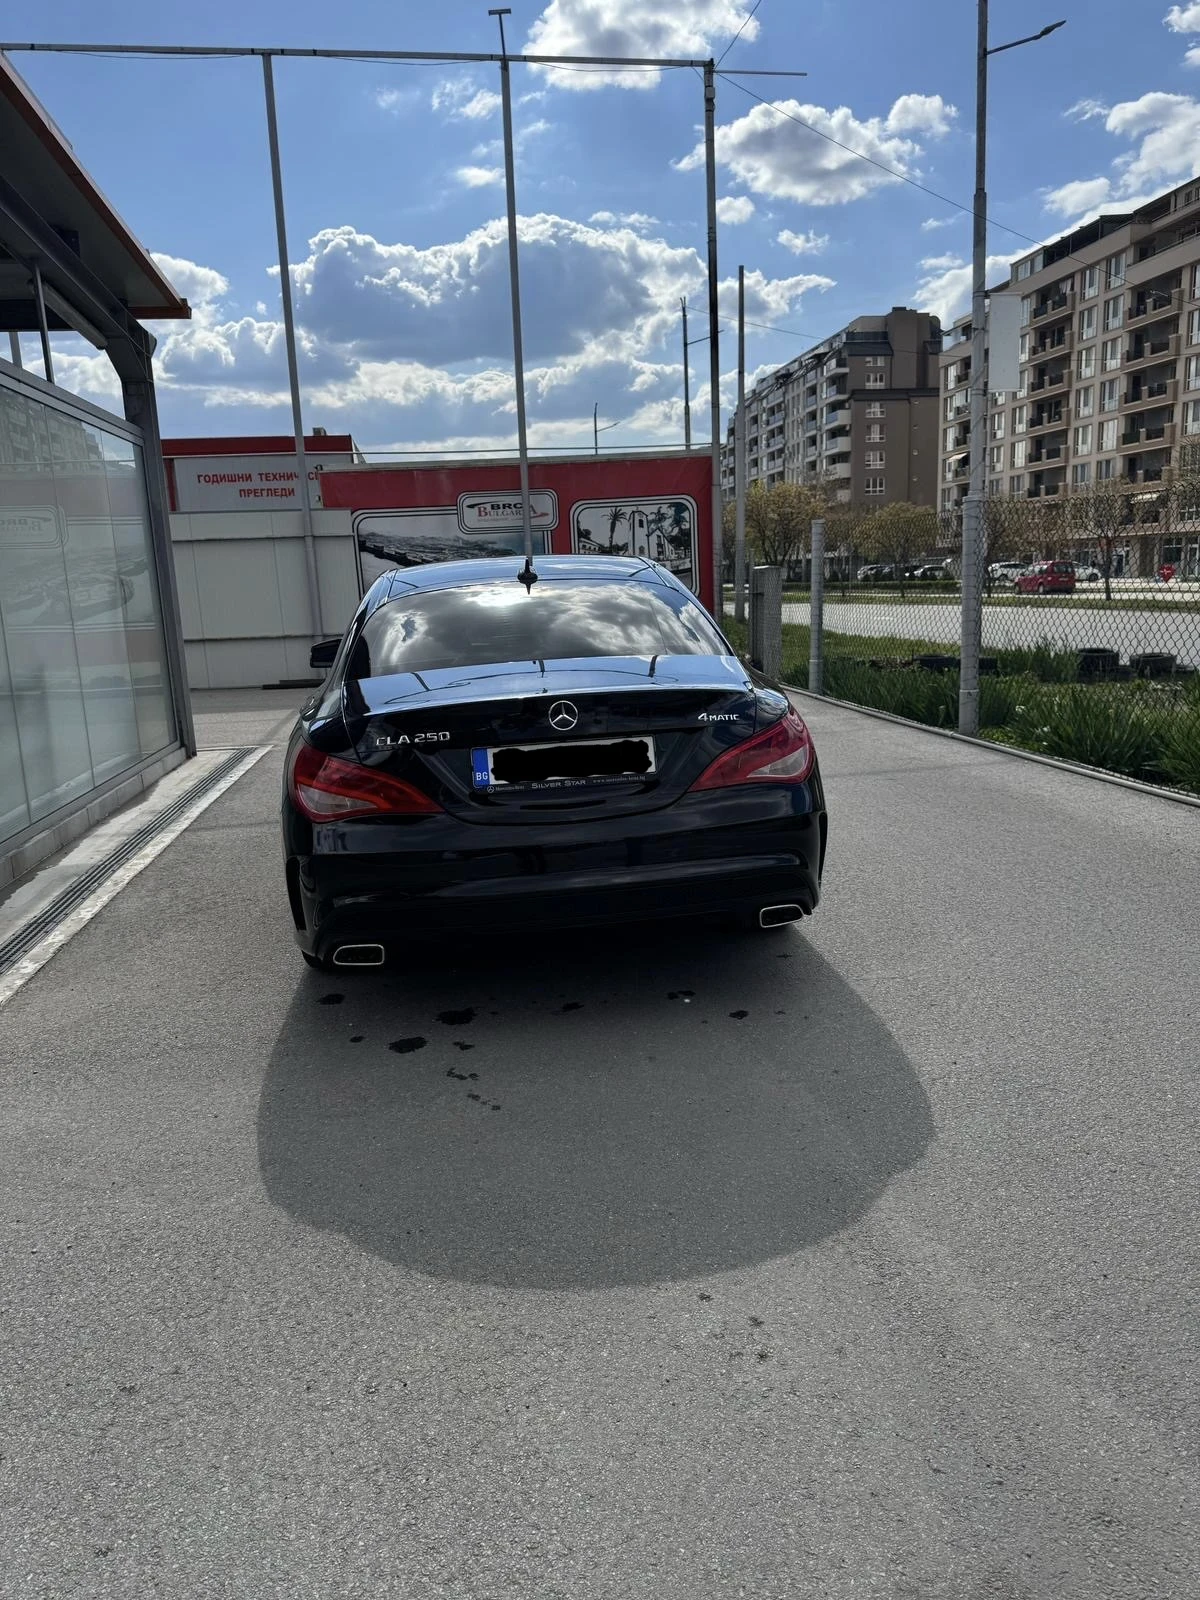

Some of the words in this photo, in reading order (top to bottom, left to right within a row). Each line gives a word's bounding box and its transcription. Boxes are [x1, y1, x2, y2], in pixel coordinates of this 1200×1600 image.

[197, 472, 253, 485] ГОДИШНИ
[239, 488, 295, 498] ПРЕГЛЕДИ
[697, 712, 740, 722] 4MATIC
[376, 735, 410, 746] CLA
[414, 731, 450, 743] 250
[476, 771, 488, 781] BG
